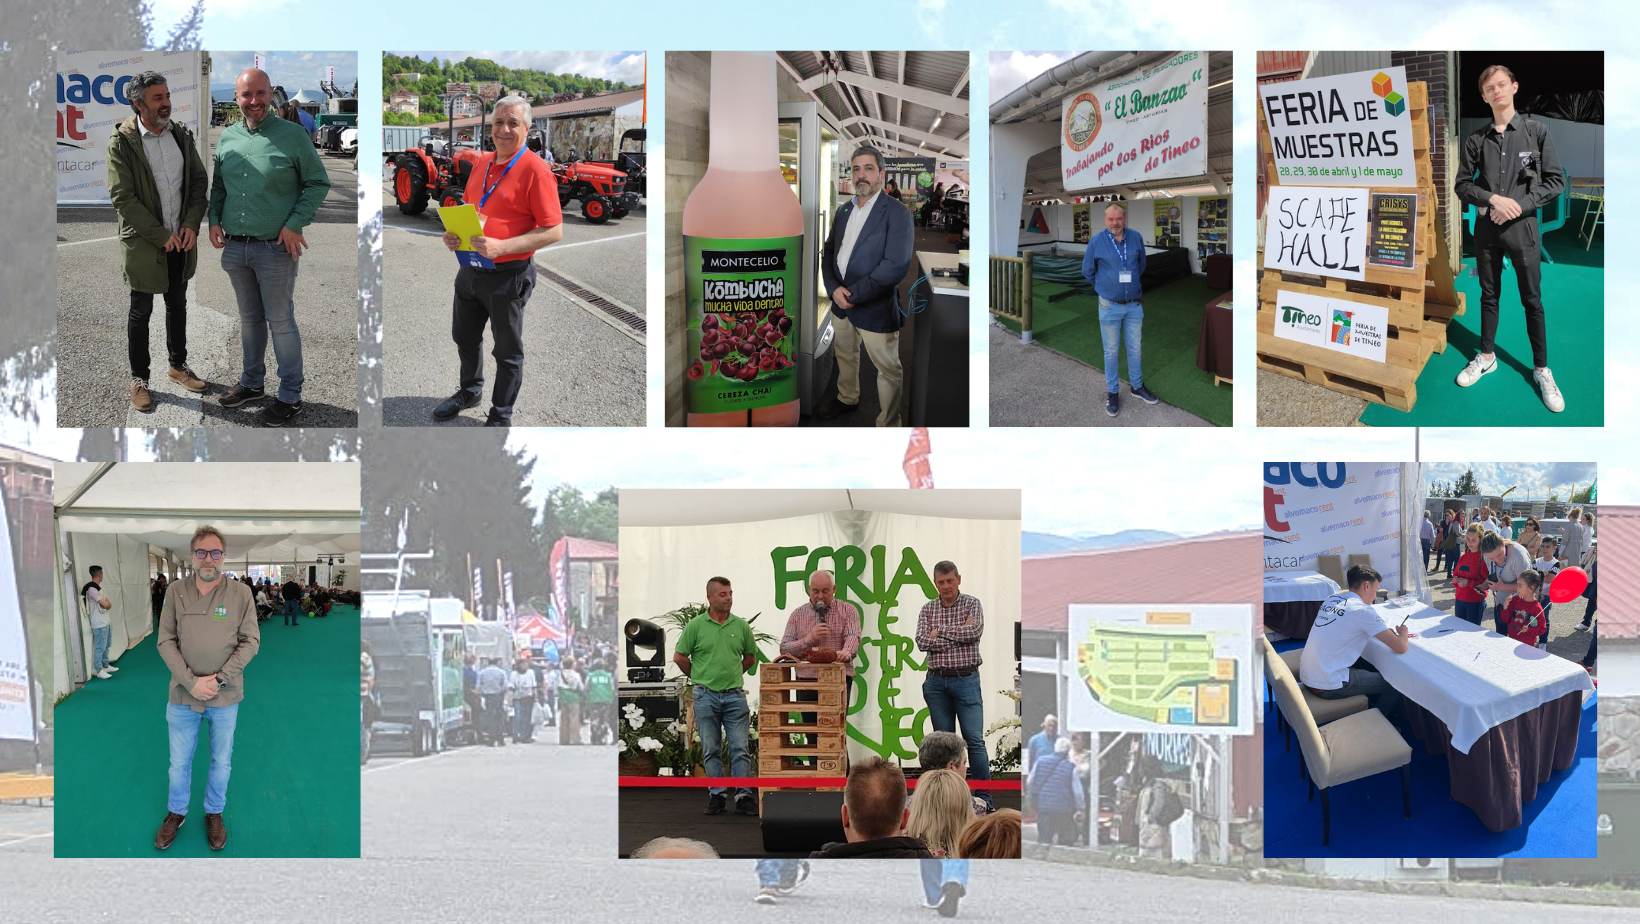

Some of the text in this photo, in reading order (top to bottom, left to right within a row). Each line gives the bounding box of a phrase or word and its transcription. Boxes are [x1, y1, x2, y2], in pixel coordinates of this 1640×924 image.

[98, 56, 144, 70] alvemaco rent
[1152, 51, 1198, 75] PESCADORES
[1266, 88, 1378, 127] FERIA DE
[82, 120, 113, 130] alvemaco
[1274, 130, 1398, 159] MUESTRAS
[1066, 142, 1114, 180] Trabajando
[1144, 136, 1201, 174] de Tineo
[1098, 161, 1114, 180] por
[1116, 148, 1137, 166] los
[1320, 167, 1330, 176] de
[1332, 167, 1349, 176] abril
[1349, 168, 1357, 178] y
[1364, 166, 1374, 176] de
[1377, 168, 1403, 178] mayo
[60, 182, 90, 194] alvemaco
[1279, 197, 1358, 233] SCAPE
[1277, 231, 1360, 272] HALL
[710, 256, 778, 267] MONTECELIO
[1281, 306, 1321, 328] Tineo
[1362, 338, 1381, 347] TINEO
[718, 387, 771, 399] CEREZA CHAI
[1354, 490, 1395, 504] alvemaco rent
[1284, 502, 1334, 518] alvemaco rent
[1320, 517, 1364, 533] alvemaco rent
[1284, 533, 1300, 542] rent
[1362, 534, 1389, 545] alvemaco
[1300, 545, 1345, 562] alvemaco rent
